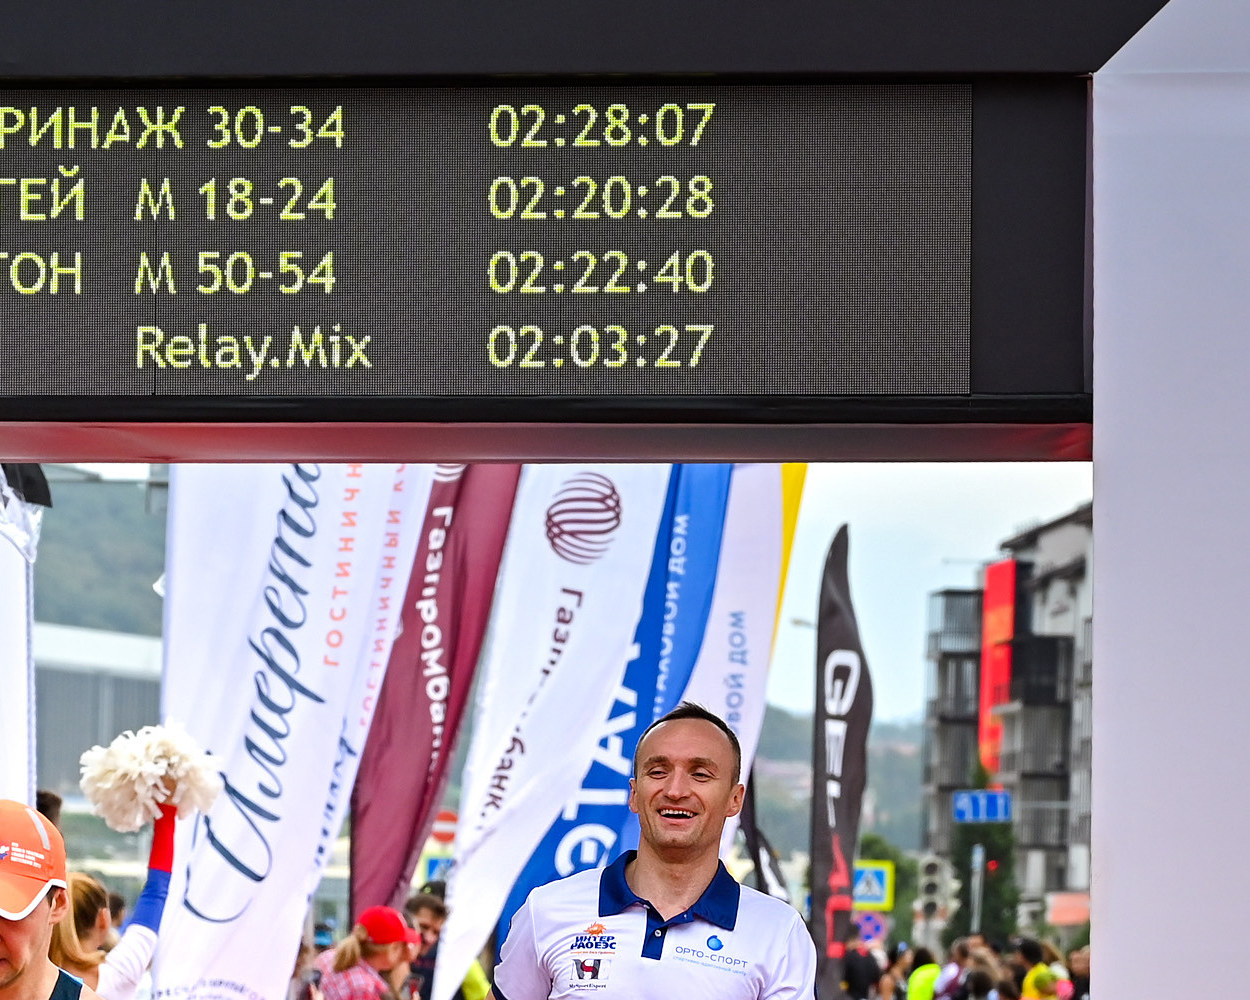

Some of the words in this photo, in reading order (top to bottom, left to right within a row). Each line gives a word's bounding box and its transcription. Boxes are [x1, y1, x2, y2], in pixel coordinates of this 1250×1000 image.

[206, 105, 346, 149] 30-34
[488, 103, 716, 148] 02:28:07
[198, 176, 337, 221] 18-24
[488, 175, 714, 220] 02:20:28
[197, 250, 337, 295] 50-54
[488, 249, 715, 294] 02:22:40
[136, 322, 372, 381] Relay.Mix
[488, 324, 714, 368] 02:03:27
[675, 946, 749, 968] ОРТО-СПОРТ
